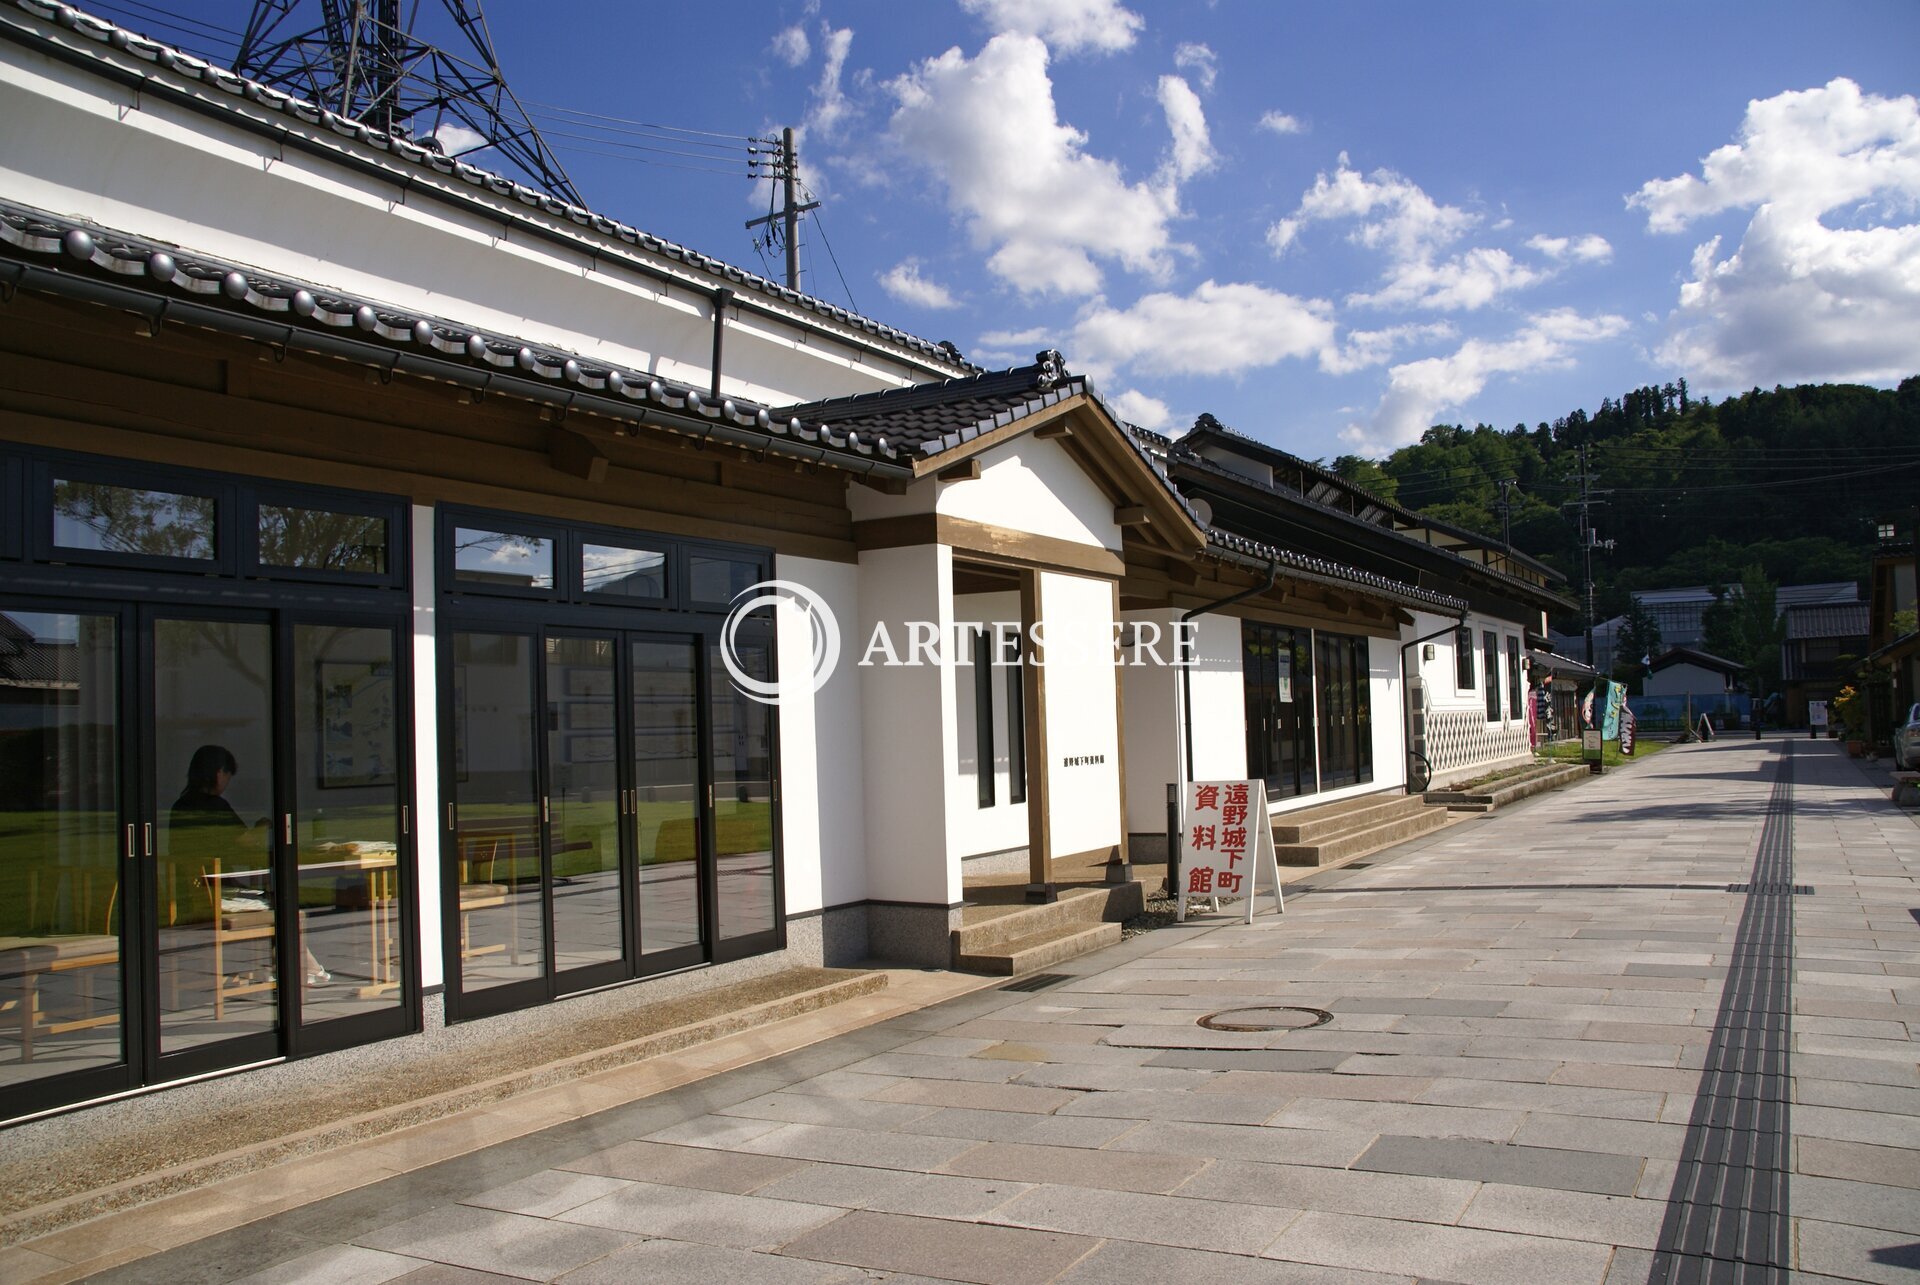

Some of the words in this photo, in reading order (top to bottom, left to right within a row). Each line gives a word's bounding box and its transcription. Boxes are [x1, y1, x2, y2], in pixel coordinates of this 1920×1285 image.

[1187, 784, 1220, 894] 資料館
[1217, 783, 1249, 893] 遠野城下町
